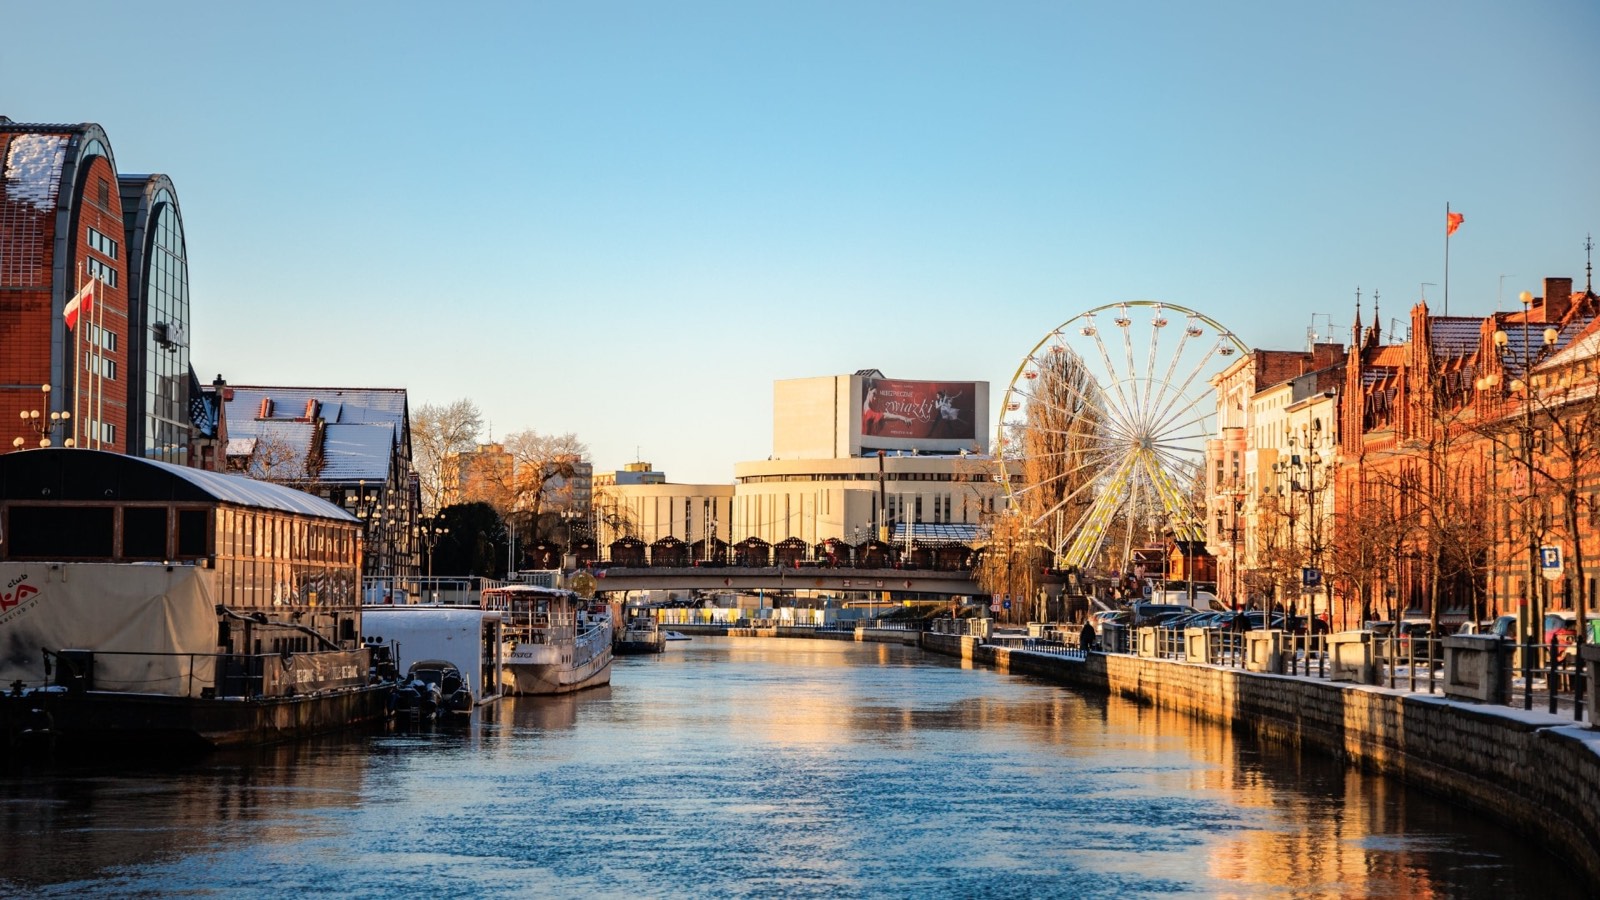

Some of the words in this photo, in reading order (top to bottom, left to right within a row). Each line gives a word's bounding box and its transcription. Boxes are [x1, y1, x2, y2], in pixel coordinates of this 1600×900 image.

[1544, 550, 1557, 567] P
[8, 574, 28, 588] club
[1307, 570, 1318, 583] P
